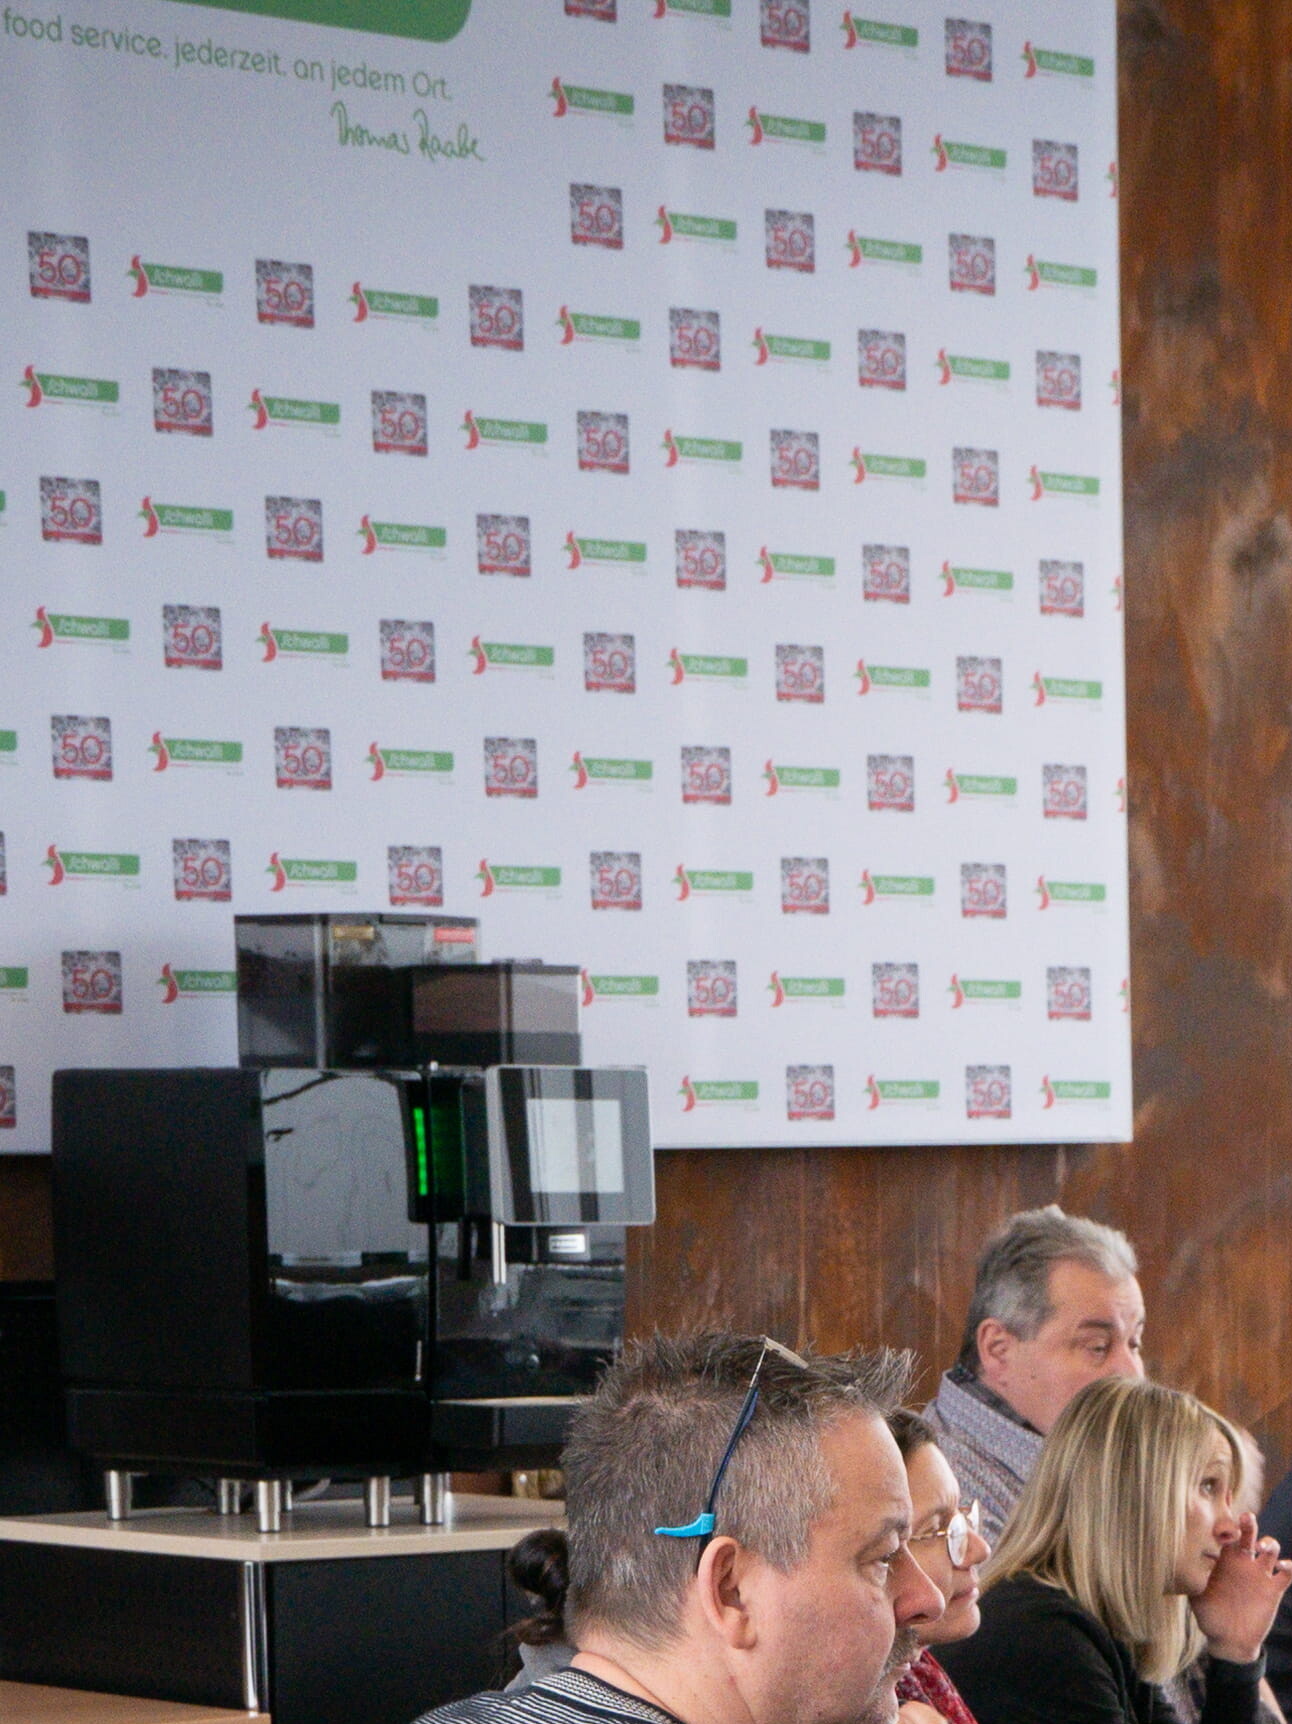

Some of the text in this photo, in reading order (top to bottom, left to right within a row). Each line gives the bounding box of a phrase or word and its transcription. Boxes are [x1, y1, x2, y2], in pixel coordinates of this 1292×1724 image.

[766, 4, 806, 37] 50
[4, 7, 62, 42] food
[70, 24, 168, 60] service.
[294, 58, 324, 82] an
[331, 60, 405, 94] jedem
[951, 33, 986, 68] 50
[669, 100, 708, 135] 50
[860, 127, 895, 161] 50
[1038, 155, 1072, 187] 50
[577, 200, 616, 234] 50
[771, 225, 808, 258] 50
[36, 249, 82, 287] 50
[955, 249, 989, 281] 50
[263, 276, 306, 313] 50
[476, 301, 516, 336] 50
[676, 323, 714, 357] 50
[864, 345, 899, 377] 50
[1042, 365, 1075, 397] 50
[160, 385, 205, 421] 50
[378, 407, 420, 441] 50
[583, 426, 622, 459] 50
[776, 445, 813, 476] 50
[958, 462, 992, 493] 50
[48, 493, 94, 529] 50
[273, 513, 315, 547] 50
[483, 530, 523, 562] 50
[682, 545, 719, 576] 50
[868, 559, 903, 590] 50
[1045, 574, 1078, 604] 50
[170, 621, 214, 655] 50
[387, 635, 428, 668] 50
[590, 648, 628, 679] 50
[781, 659, 817, 690] 50
[962, 671, 996, 700] 50
[59, 732, 104, 765] 50
[282, 743, 324, 775] 50
[491, 753, 530, 784] 50
[687, 761, 725, 791] 50
[873, 769, 908, 798] 50
[1048, 778, 1081, 807] 50
[180, 855, 224, 887] 50
[395, 862, 436, 892] 50
[596, 867, 635, 897] 50
[787, 872, 823, 901] 50
[966, 877, 1000, 905] 50
[69, 967, 114, 999] 50
[693, 975, 730, 1003] 50
[878, 977, 913, 1005] 50
[1052, 981, 1085, 1008] 50
[792, 1080, 828, 1107] 50
[971, 1079, 1005, 1106] 50
